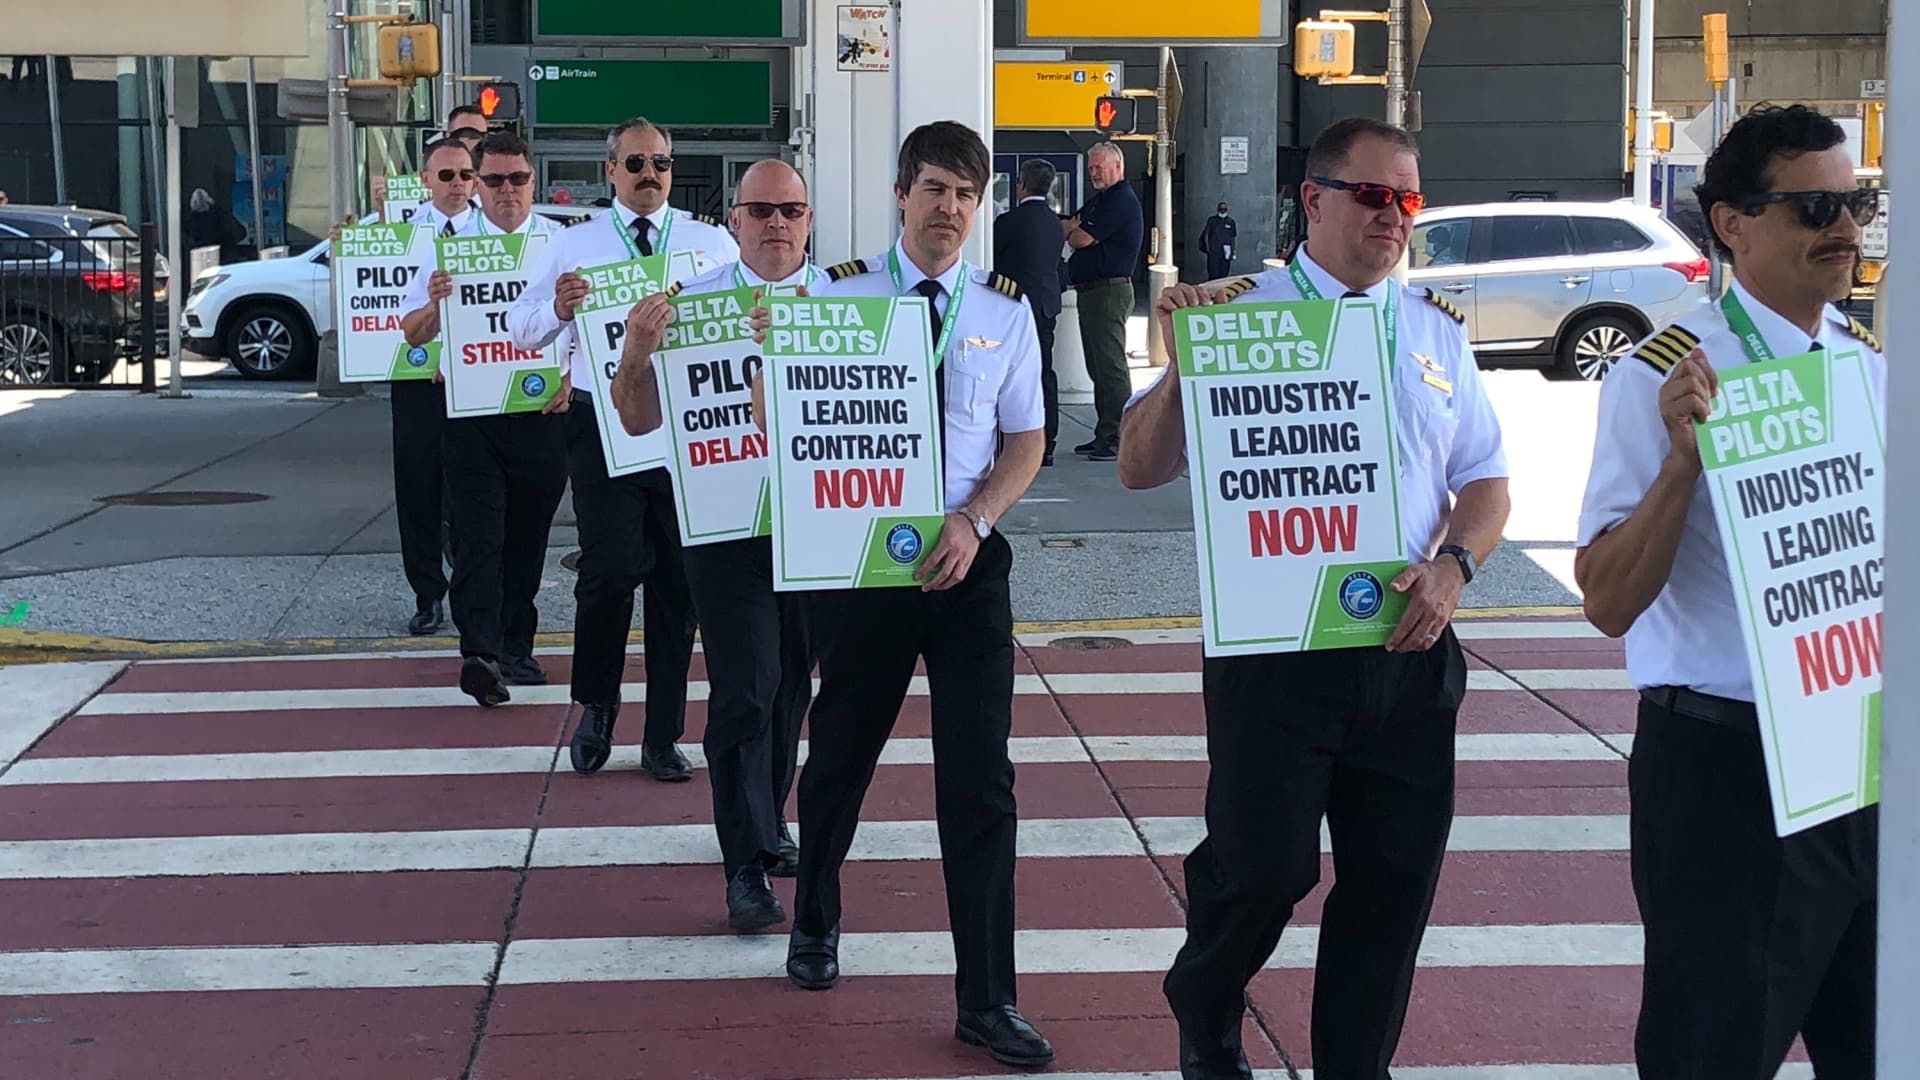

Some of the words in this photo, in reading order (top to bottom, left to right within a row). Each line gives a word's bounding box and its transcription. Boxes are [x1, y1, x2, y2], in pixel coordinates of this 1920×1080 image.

[850, 8, 886, 20] WATCH
[561, 69, 597, 78] AirTrain
[1036, 72, 1072, 81] Terminal
[1075, 71, 1085, 82] 4
[387, 178, 422, 188] DELT
[389, 188, 432, 200] PILOT
[342, 228, 397, 241] DELTA
[342, 242, 404, 256] PILOTS
[443, 239, 506, 257] DELTA
[444, 255, 515, 273] PILOTS
[350, 295, 407, 309] CONTR
[771, 303, 863, 327] DELTA
[662, 317, 753, 348] PILOTS
[1188, 311, 1302, 342] DELTA
[773, 330, 878, 353] PILOTS
[1192, 340, 1320, 373] PILOTS
[687, 355, 763, 397] PILO
[786, 365, 917, 391] INDUSTRY-
[1209, 380, 1370, 417] INDUSTRY-
[1706, 369, 1804, 423] DELTA
[802, 399, 908, 425] LEADING
[791, 434, 921, 461] CONTRACT
[1230, 422, 1360, 458] LEADING
[1710, 405, 1825, 463] PILOTS
[814, 468, 904, 509] NOW
[1219, 463, 1378, 501] CONTRACT
[1736, 451, 1875, 519] INDUSTRY-
[1248, 504, 1358, 557] NOW
[1763, 506, 1875, 570] LEADING
[1763, 558, 1885, 628] CONTRAC
[1794, 612, 1884, 697] NOW
